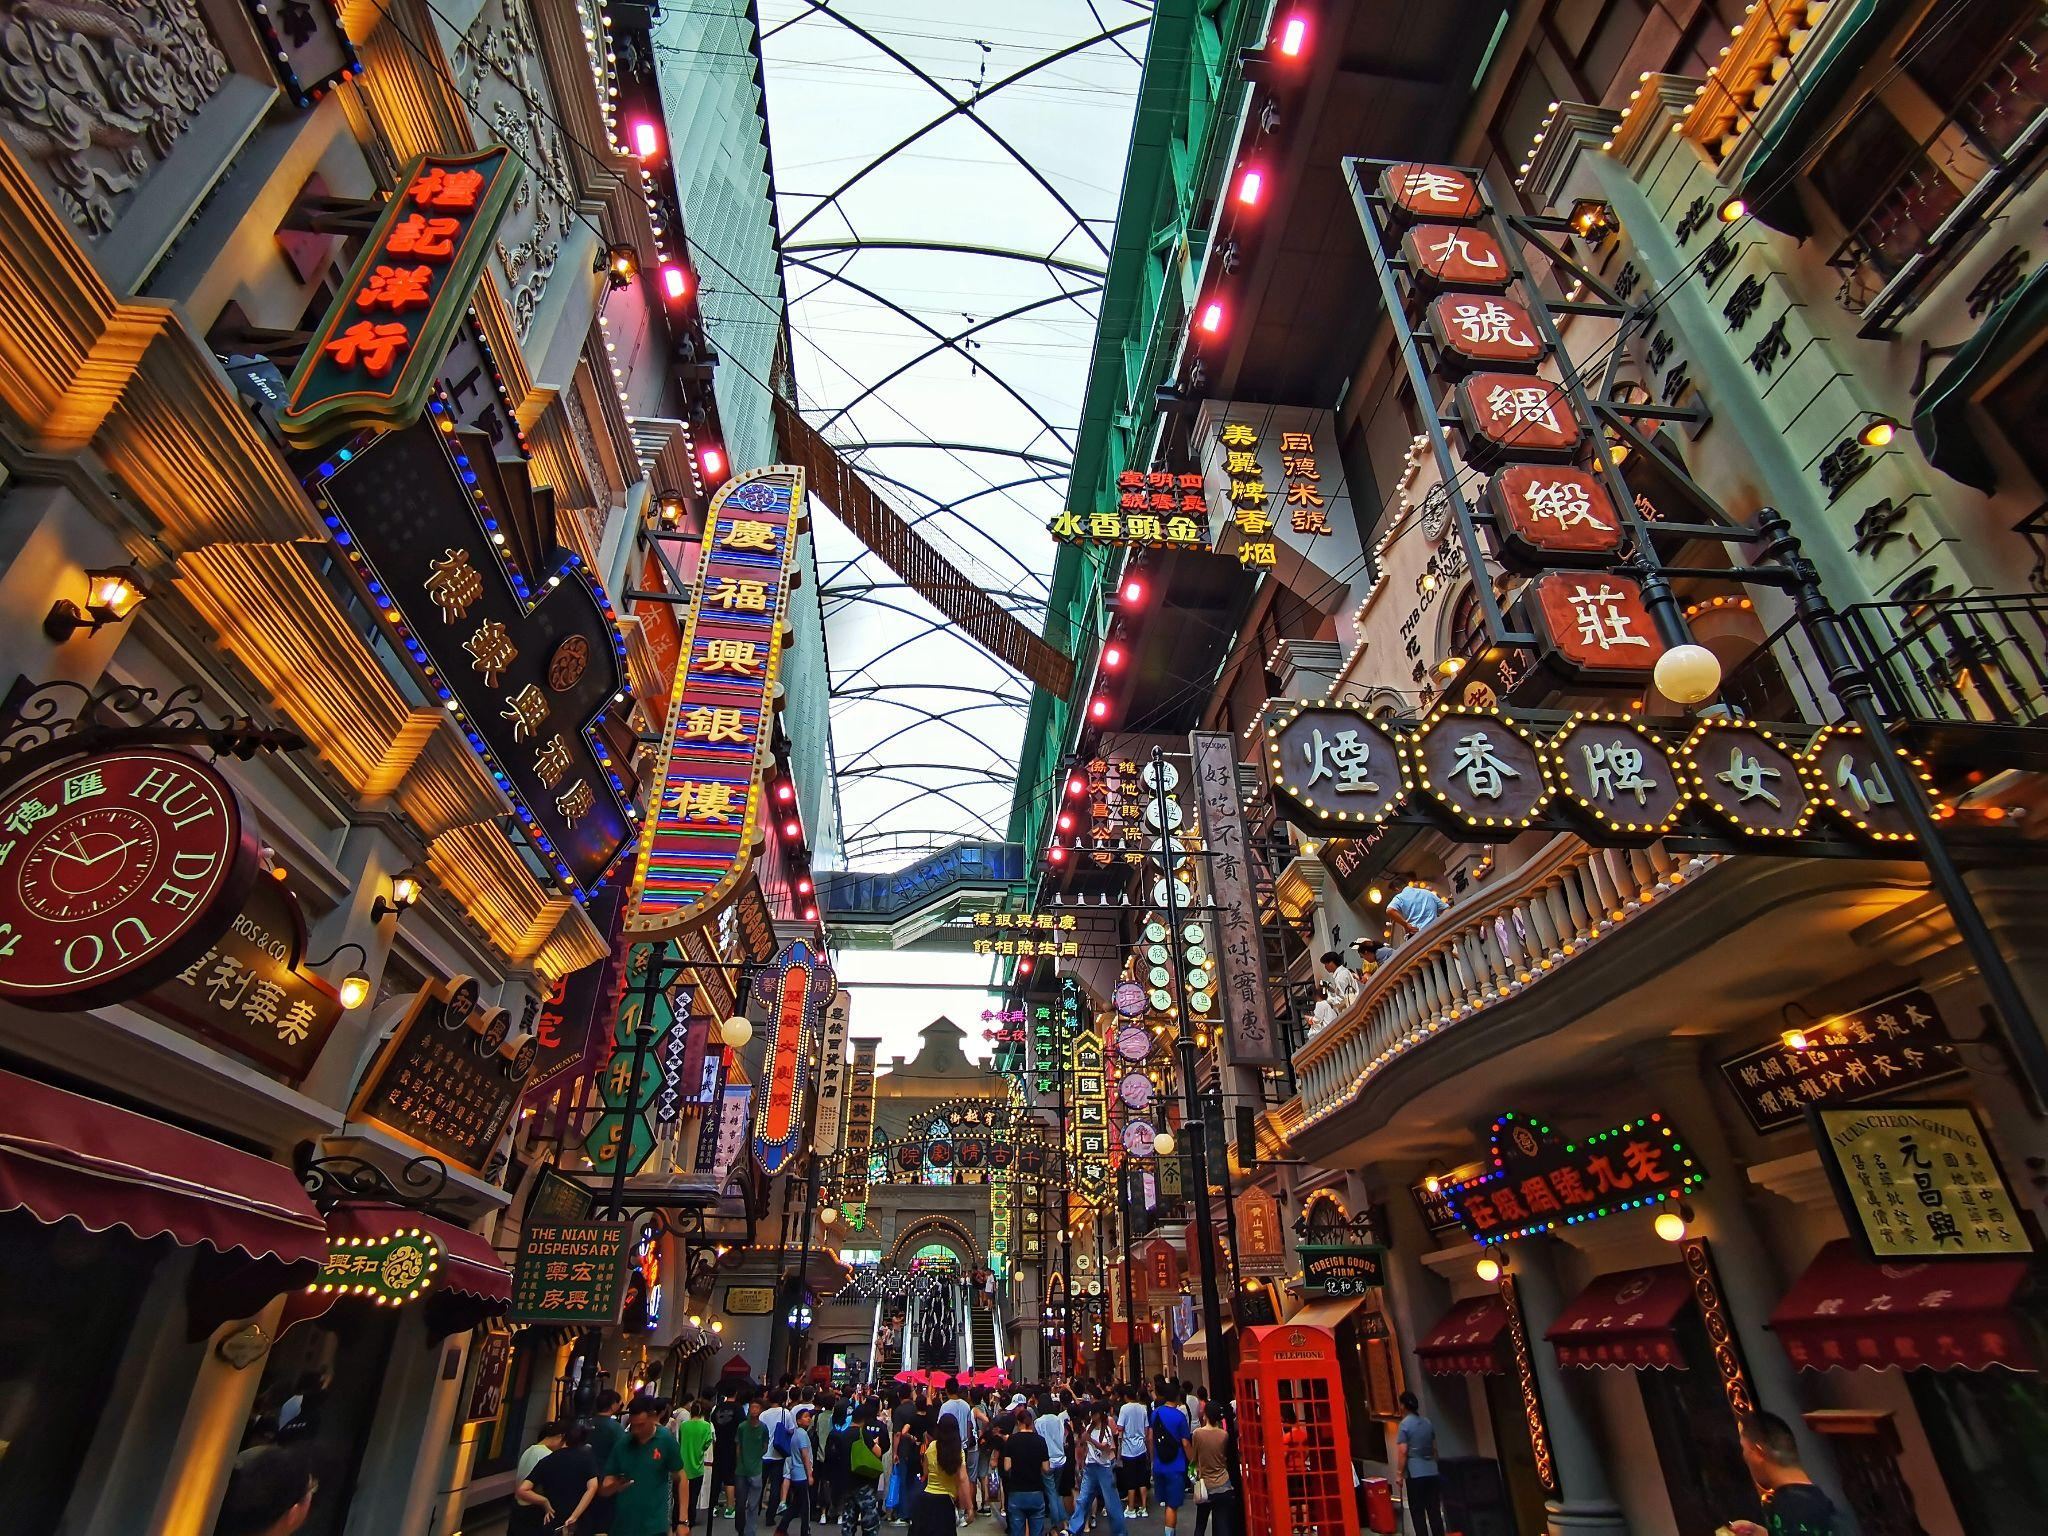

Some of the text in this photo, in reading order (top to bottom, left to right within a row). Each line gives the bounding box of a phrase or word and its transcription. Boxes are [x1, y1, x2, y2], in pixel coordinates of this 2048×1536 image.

[247, 372, 277, 400] MIPRO
[1404, 168, 1648, 651] 老九號綢緞莊
[667, 519, 777, 821] 慶福興銀樓
[129, 767, 215, 832] HUI
[151, 850, 217, 912] DE
[268, 939, 288, 964] CO.
[1162, 1160, 1181, 1184] 茶
[1897, 1134, 1964, 1248] 元昌興
[531, 1227, 621, 1242] THE NIAN HE
[527, 1242, 620, 1256] DISPENSARY
[1308, 1254, 1377, 1276] FOREIGN GOODS
[1331, 1267, 1356, 1277] FIRM
[1273, 1350, 1325, 1360] TELEPHONE
